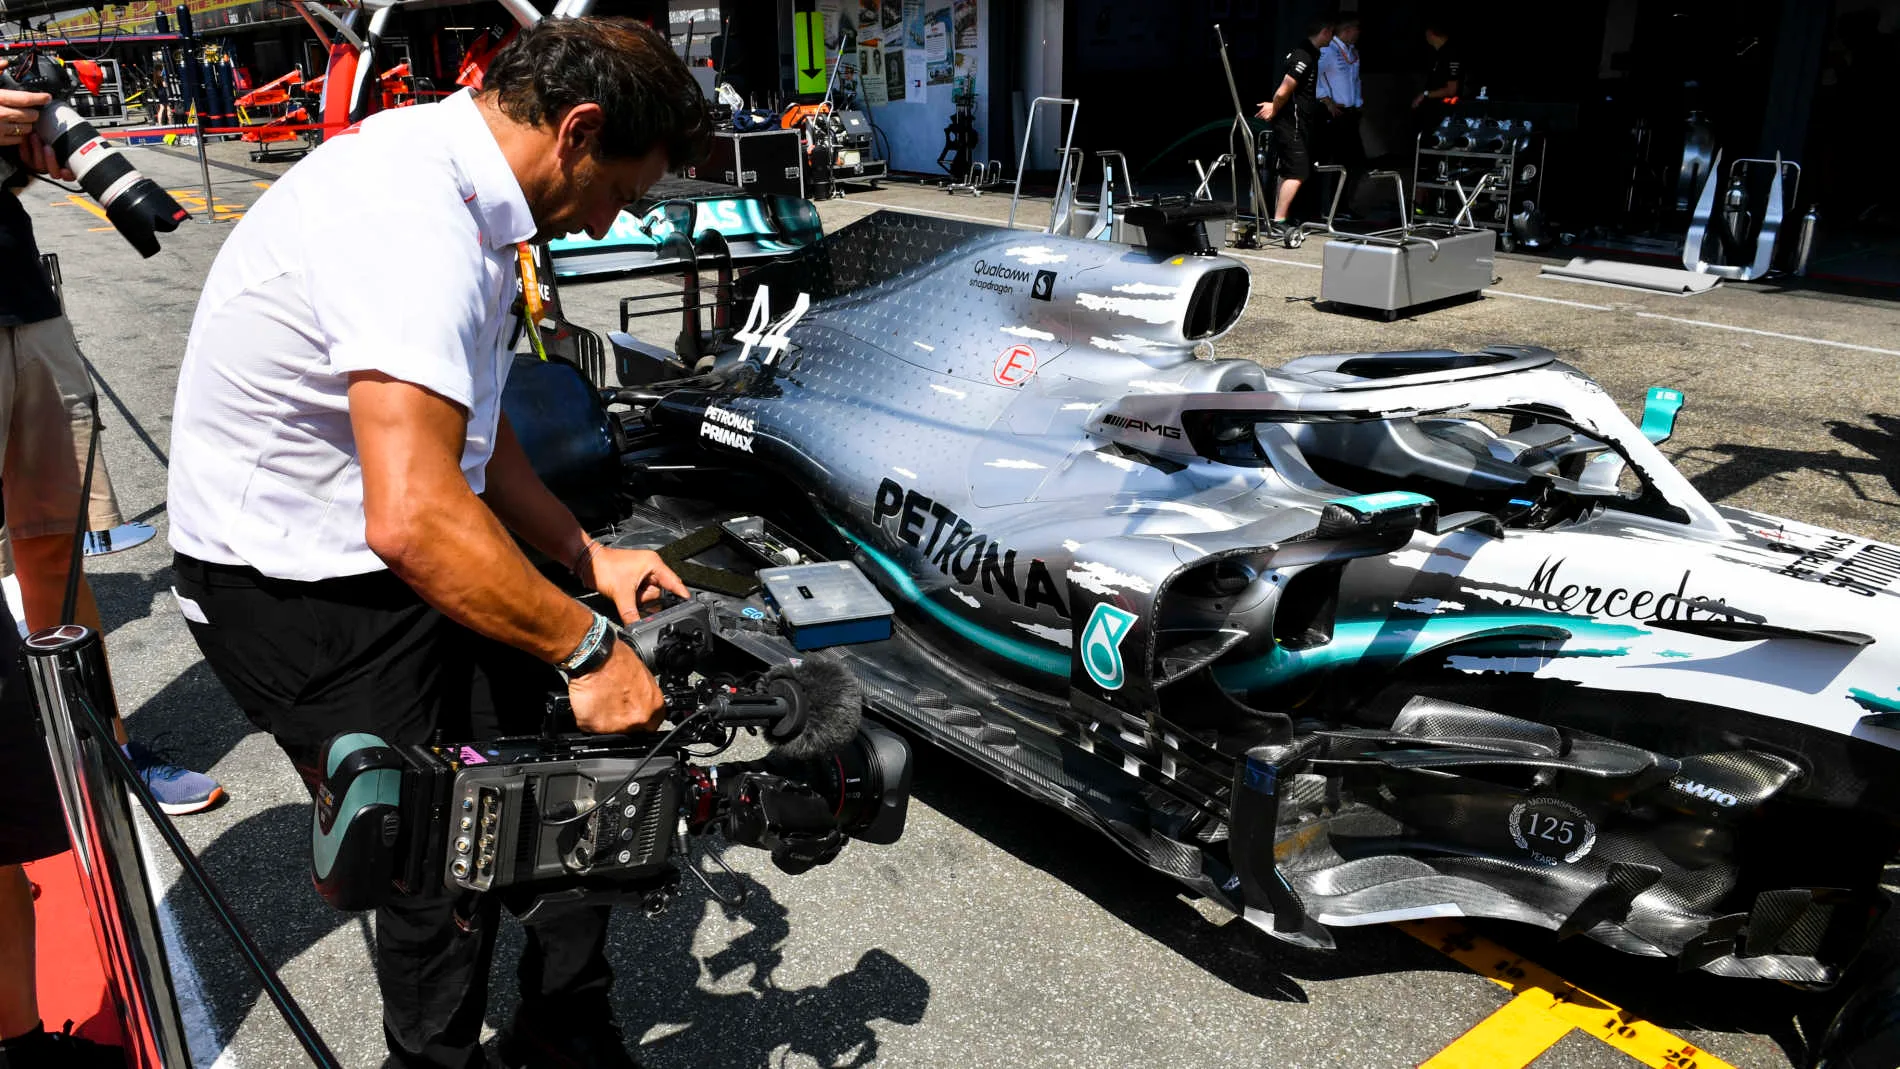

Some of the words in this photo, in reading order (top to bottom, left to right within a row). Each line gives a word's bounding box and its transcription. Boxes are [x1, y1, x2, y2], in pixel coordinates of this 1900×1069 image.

[974, 259, 1030, 283] Qualcomm
[969, 279, 1013, 295] snapdragon
[733, 284, 810, 366] 44
[704, 405, 754, 432] PETRONAS
[1125, 418, 1181, 440] AMG
[700, 421, 754, 454] PRIMAX
[1779, 535, 1856, 581] PETRONAS
[1527, 812, 1575, 845] 125
[1530, 849, 1558, 866] YEARS
[1603, 1018, 1637, 1039] 10
[1661, 1048, 1698, 1069] 20
